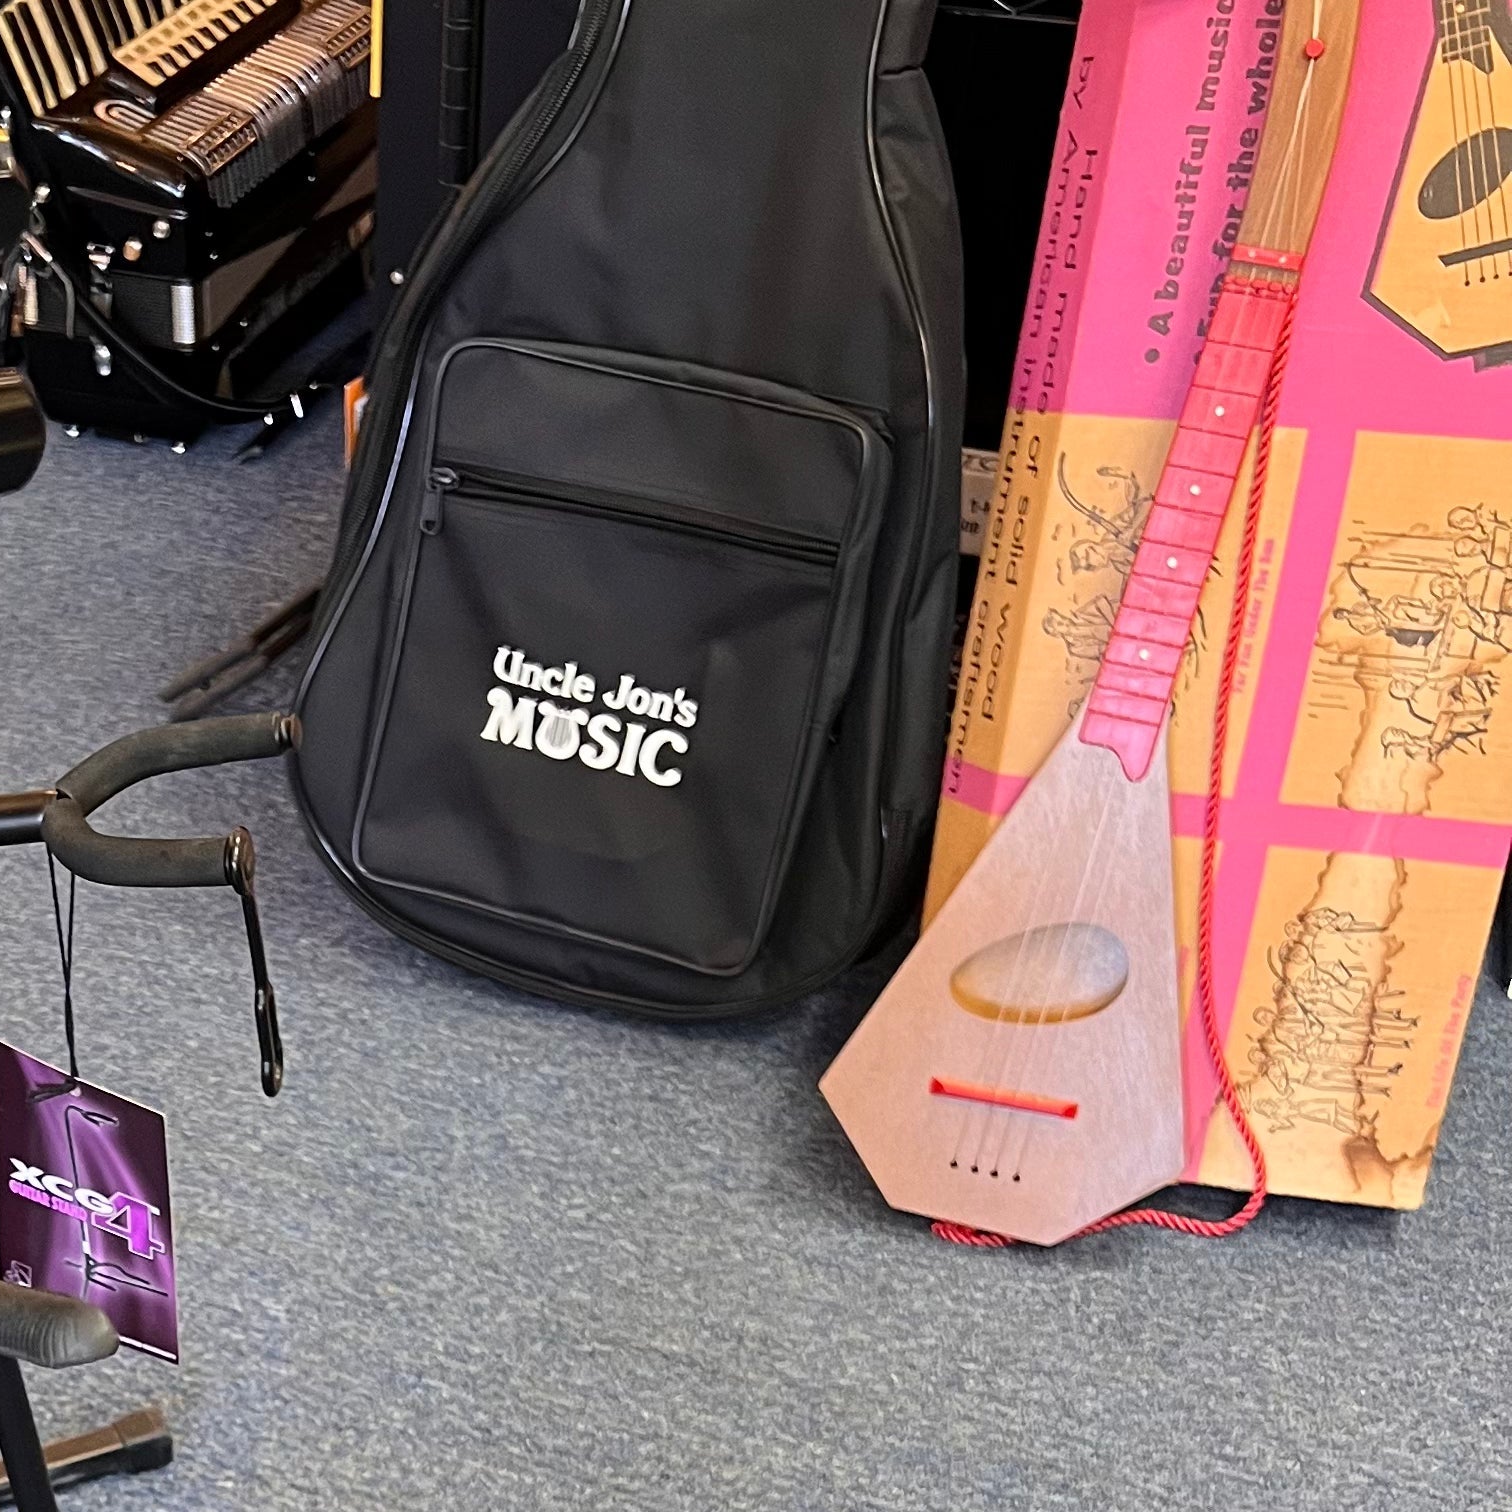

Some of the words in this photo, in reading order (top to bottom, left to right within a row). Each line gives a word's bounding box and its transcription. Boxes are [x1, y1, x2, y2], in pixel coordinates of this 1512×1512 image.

[1072, 56, 1094, 110] by
[1063, 149, 1097, 269] Hand
[1225, 127, 1259, 192] the
[1029, 129, 1079, 338] American
[1154, 124, 1210, 301] beautiful
[1211, 203, 1244, 261] for
[1037, 292, 1067, 414] made
[1147, 310, 1174, 337] A
[986, 356, 1037, 580] instrument
[1026, 434, 1041, 479] of
[1005, 495, 1031, 586] solid
[493, 645, 596, 703] Uncle
[602, 673, 699, 729] Jon's
[948, 600, 990, 794] craftsmen
[981, 602, 1011, 722] wood
[480, 685, 689, 787] MUSIC
